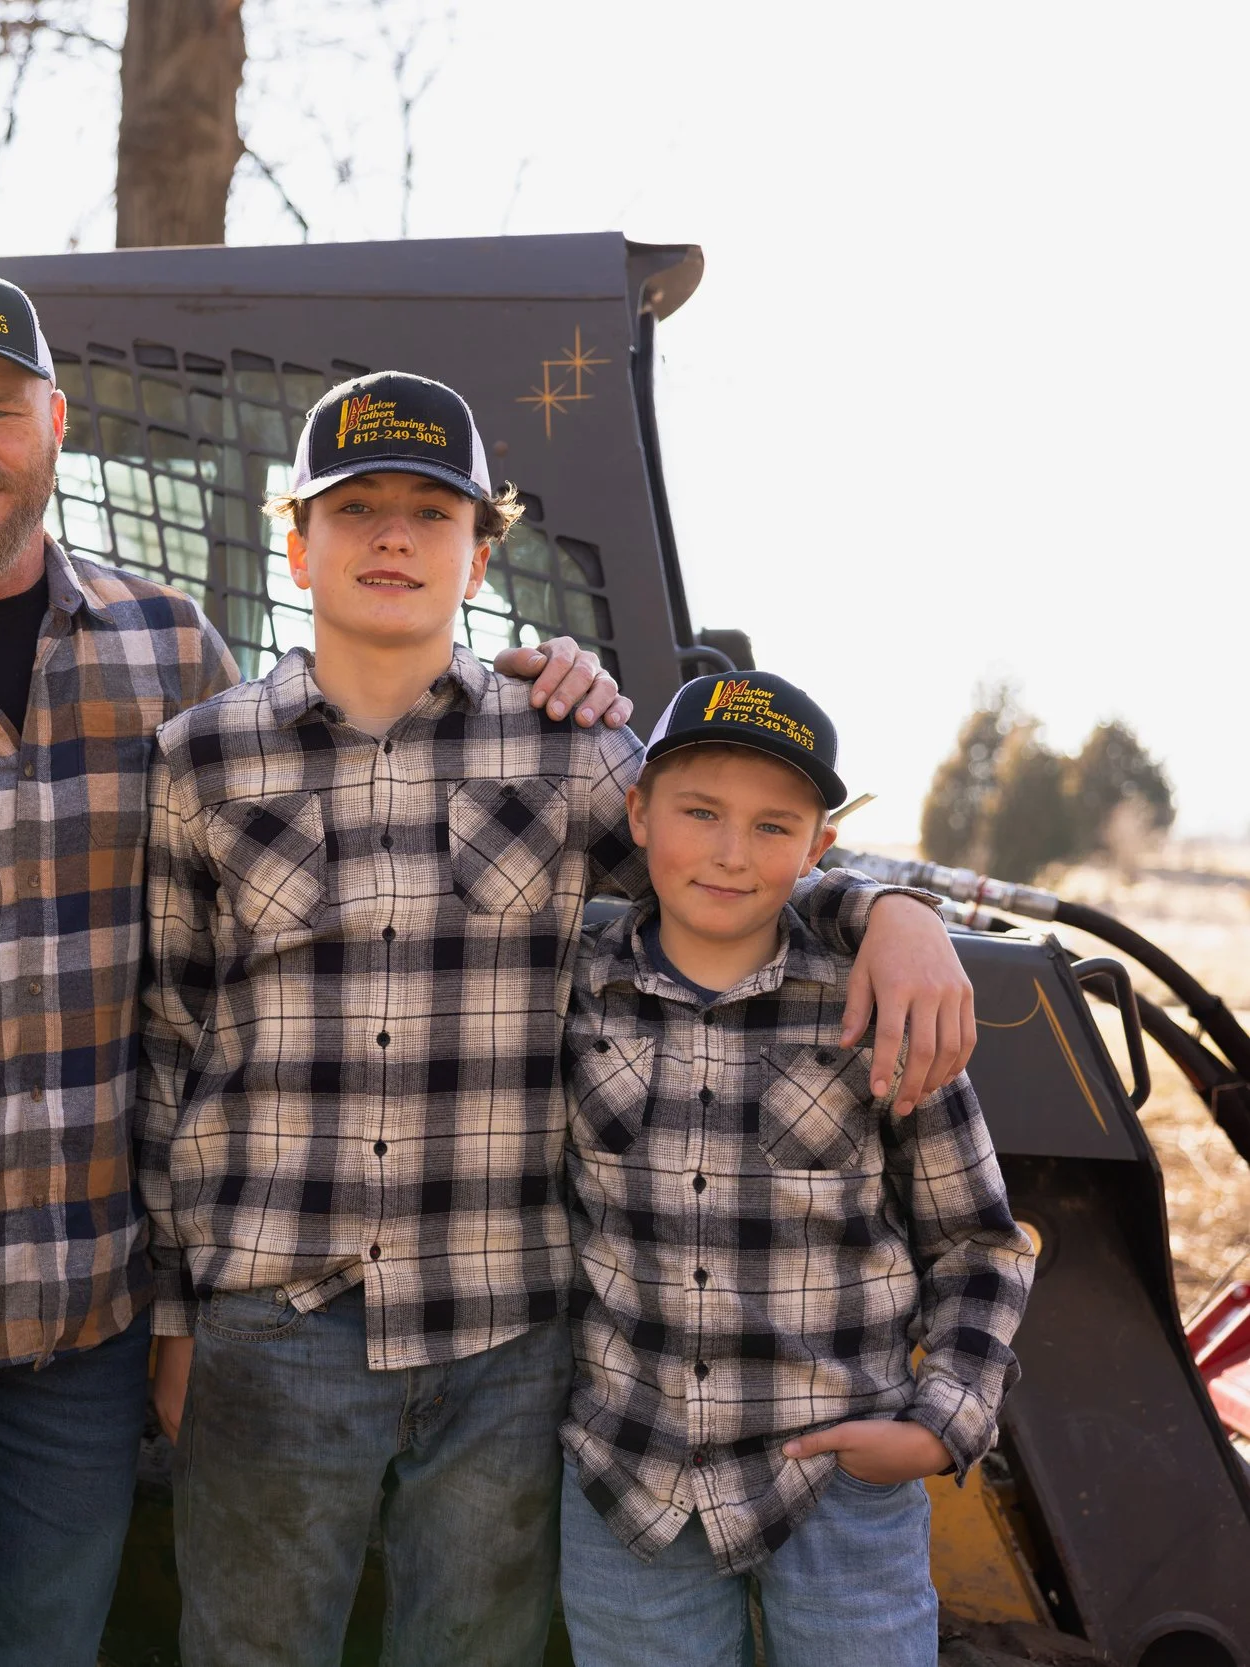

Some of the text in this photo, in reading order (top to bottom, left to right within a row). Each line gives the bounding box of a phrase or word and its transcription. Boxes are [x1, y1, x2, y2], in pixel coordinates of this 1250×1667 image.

[351, 394, 397, 413] Marlow
[348, 410, 395, 429] Brothers
[357, 417, 446, 435] Land Clearing, Inc.
[353, 430, 447, 447] 812-249-9033
[723, 680, 775, 699] Marlow
[720, 694, 771, 708] Brothers
[727, 703, 815, 740] Land Clearing, Inc.
[722, 712, 814, 751] 812-249-9033
